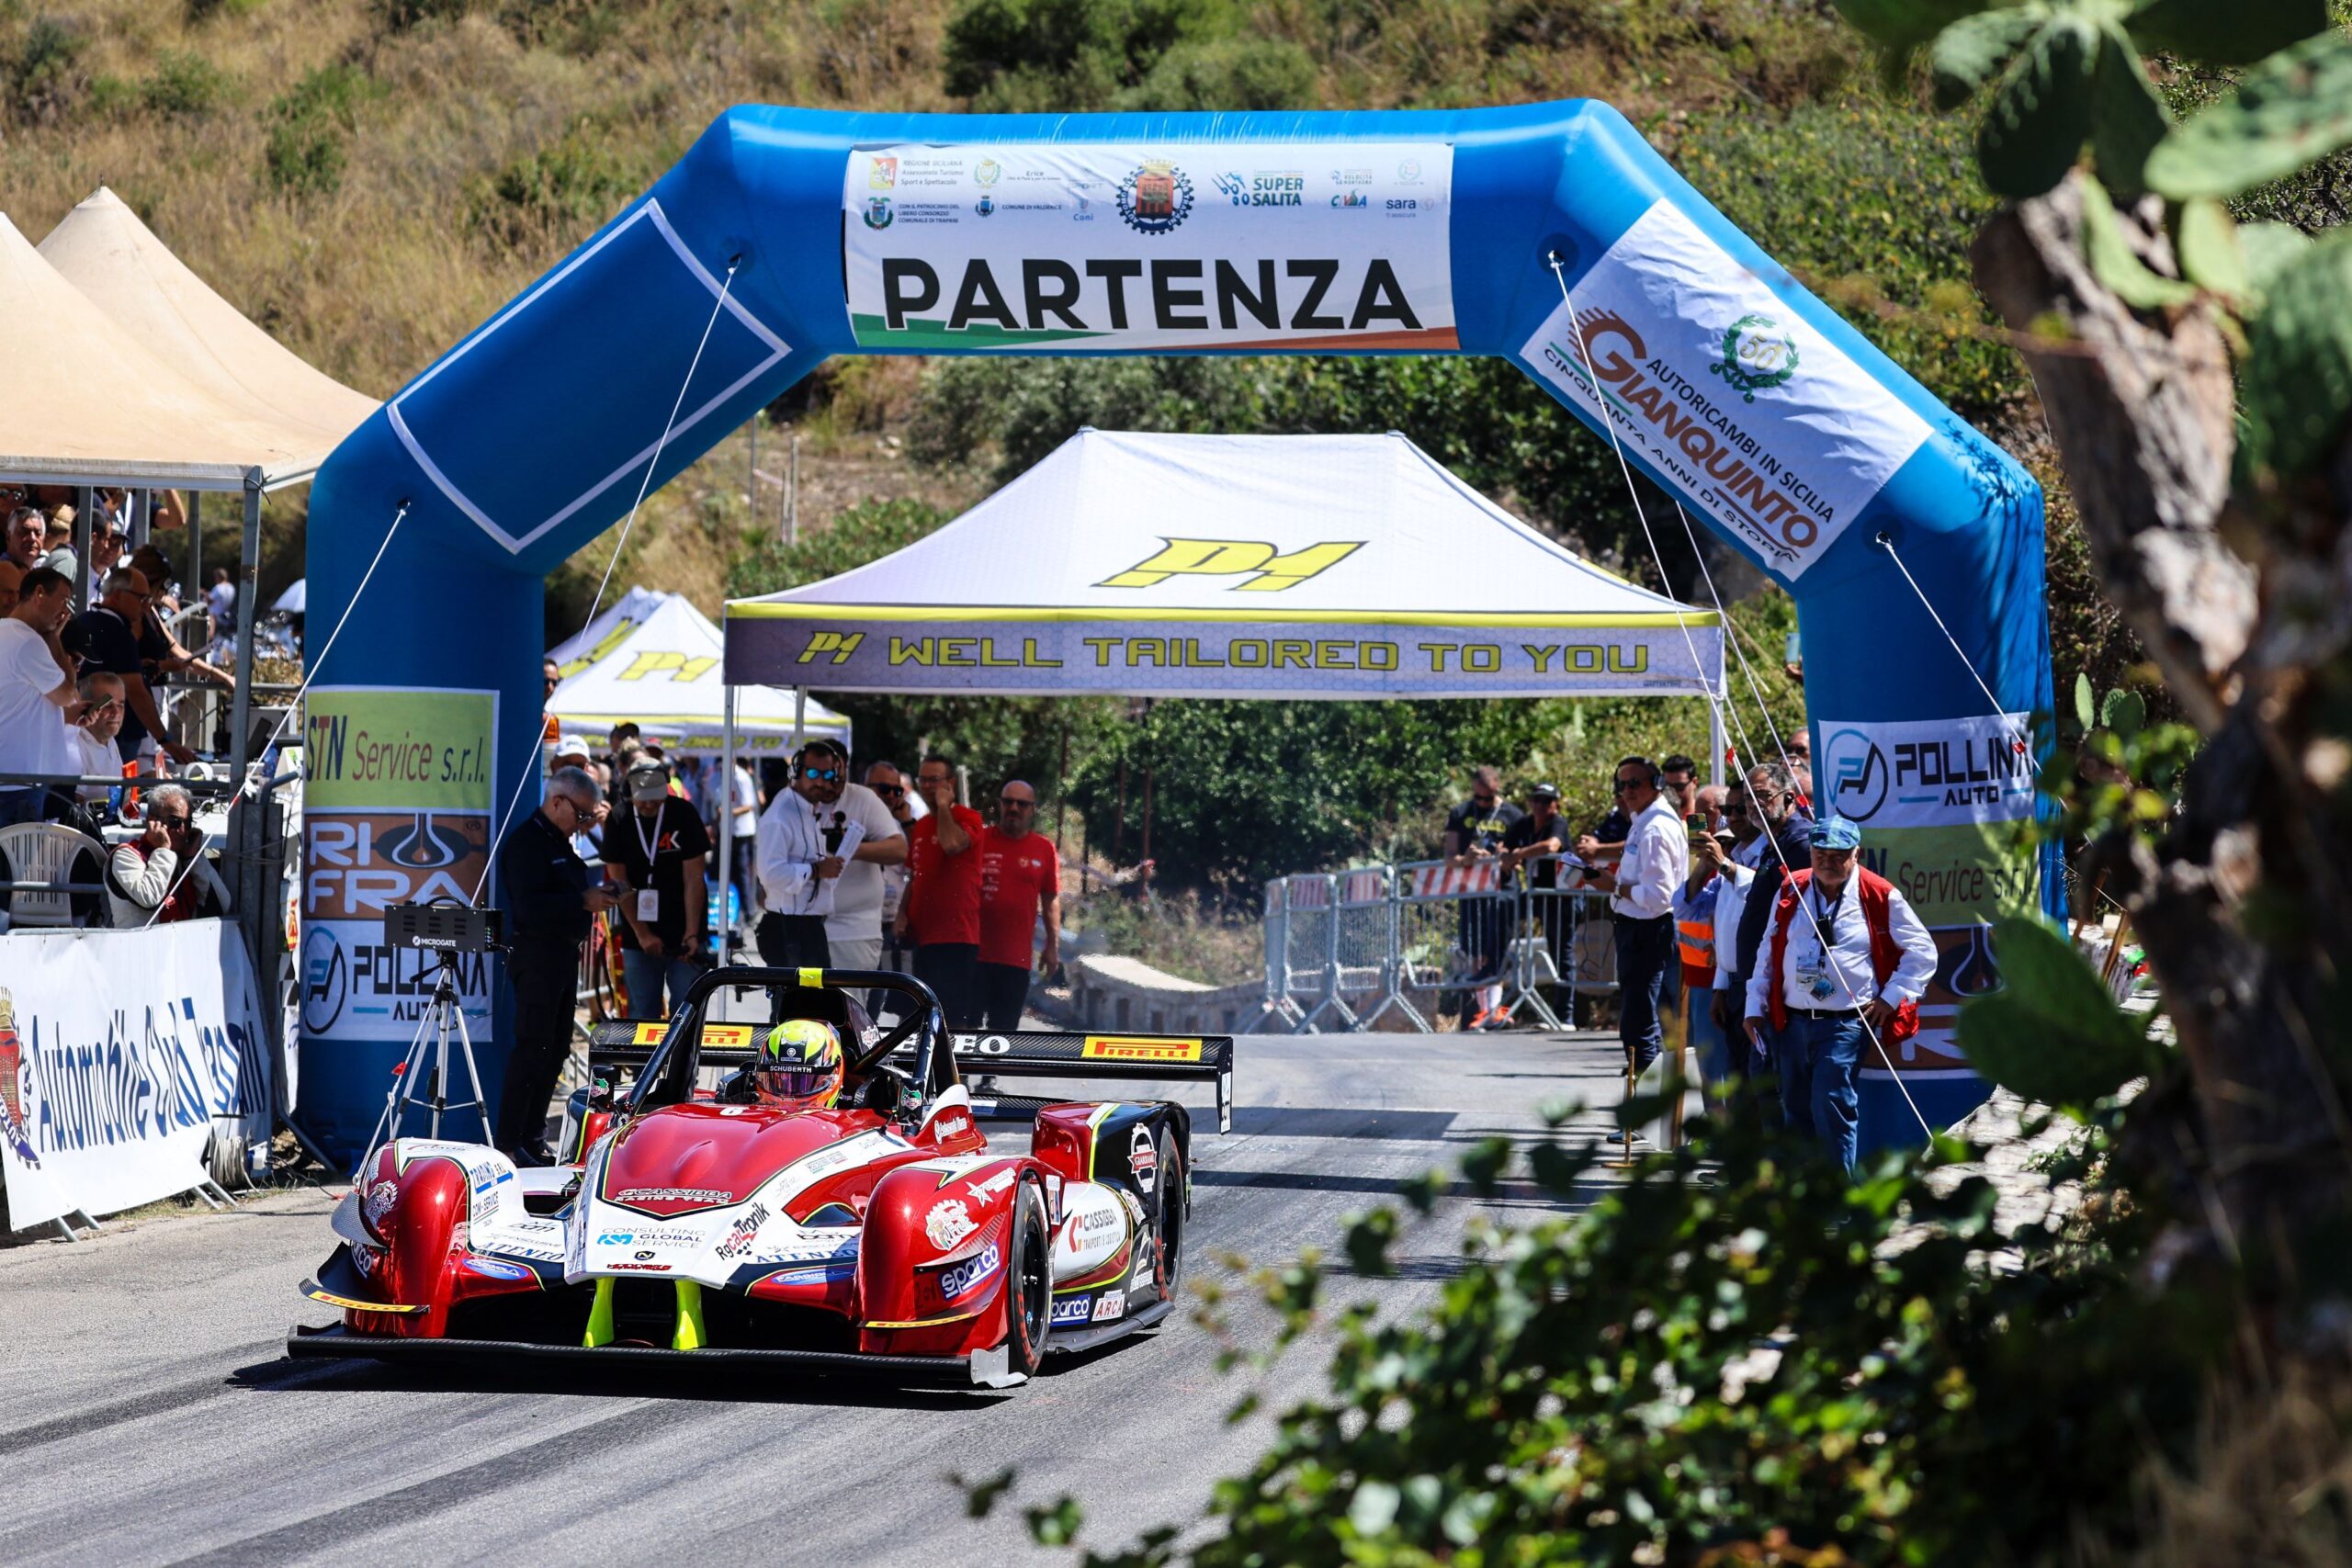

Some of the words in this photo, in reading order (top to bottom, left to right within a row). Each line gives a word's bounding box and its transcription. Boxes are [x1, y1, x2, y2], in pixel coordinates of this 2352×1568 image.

[1253, 177, 1304, 191] SUPER
[1251, 192, 1303, 207] SALITA
[1385, 198, 1417, 209] sara
[1072, 212, 1094, 221] Coni
[881, 257, 1424, 330] PARTENZA
[1566, 306, 1819, 549] GIANQUINTO
[1645, 357, 1762, 459] AUTORICAMBI
[1758, 452, 1782, 477] IN
[1779, 469, 1836, 525] SICILIA
[1544, 348, 1647, 446] CINQUANTA
[1650, 447, 1698, 489] ANNI
[1700, 489, 1720, 510] DI
[1723, 509, 1795, 564] STORIA
[888, 637, 1064, 669] WELL
[1082, 637, 1399, 672] TAILORED
[1418, 643, 1501, 673] TO
[1521, 643, 1649, 674] YOU
[305, 715, 348, 784] STN
[352, 730, 434, 783] Service
[440, 736, 485, 784] s.r.l.
[1894, 736, 2033, 787] POLLINA
[1944, 785, 2000, 807] AUTO
[309, 821, 372, 866] RI
[1898, 859, 1985, 906] Service
[421, 937, 457, 948] MICROGATE
[1093, 1041, 1191, 1058] PIRELLI
[769, 1065, 812, 1074] SCHUBERTH
[32, 1009, 152, 1154] Automobile
[1083, 1207, 1118, 1232] CASSIBBA
[602, 1226, 706, 1236] CONSULTING
[639, 1234, 703, 1243] GLOBAL
[477, 1242, 565, 1261] ATENEO
[631, 1239, 700, 1249] SERVICE
[756, 1248, 857, 1263] ATENEO
[941, 1244, 999, 1293] sparco
[1095, 1300, 1122, 1317] ARCA
